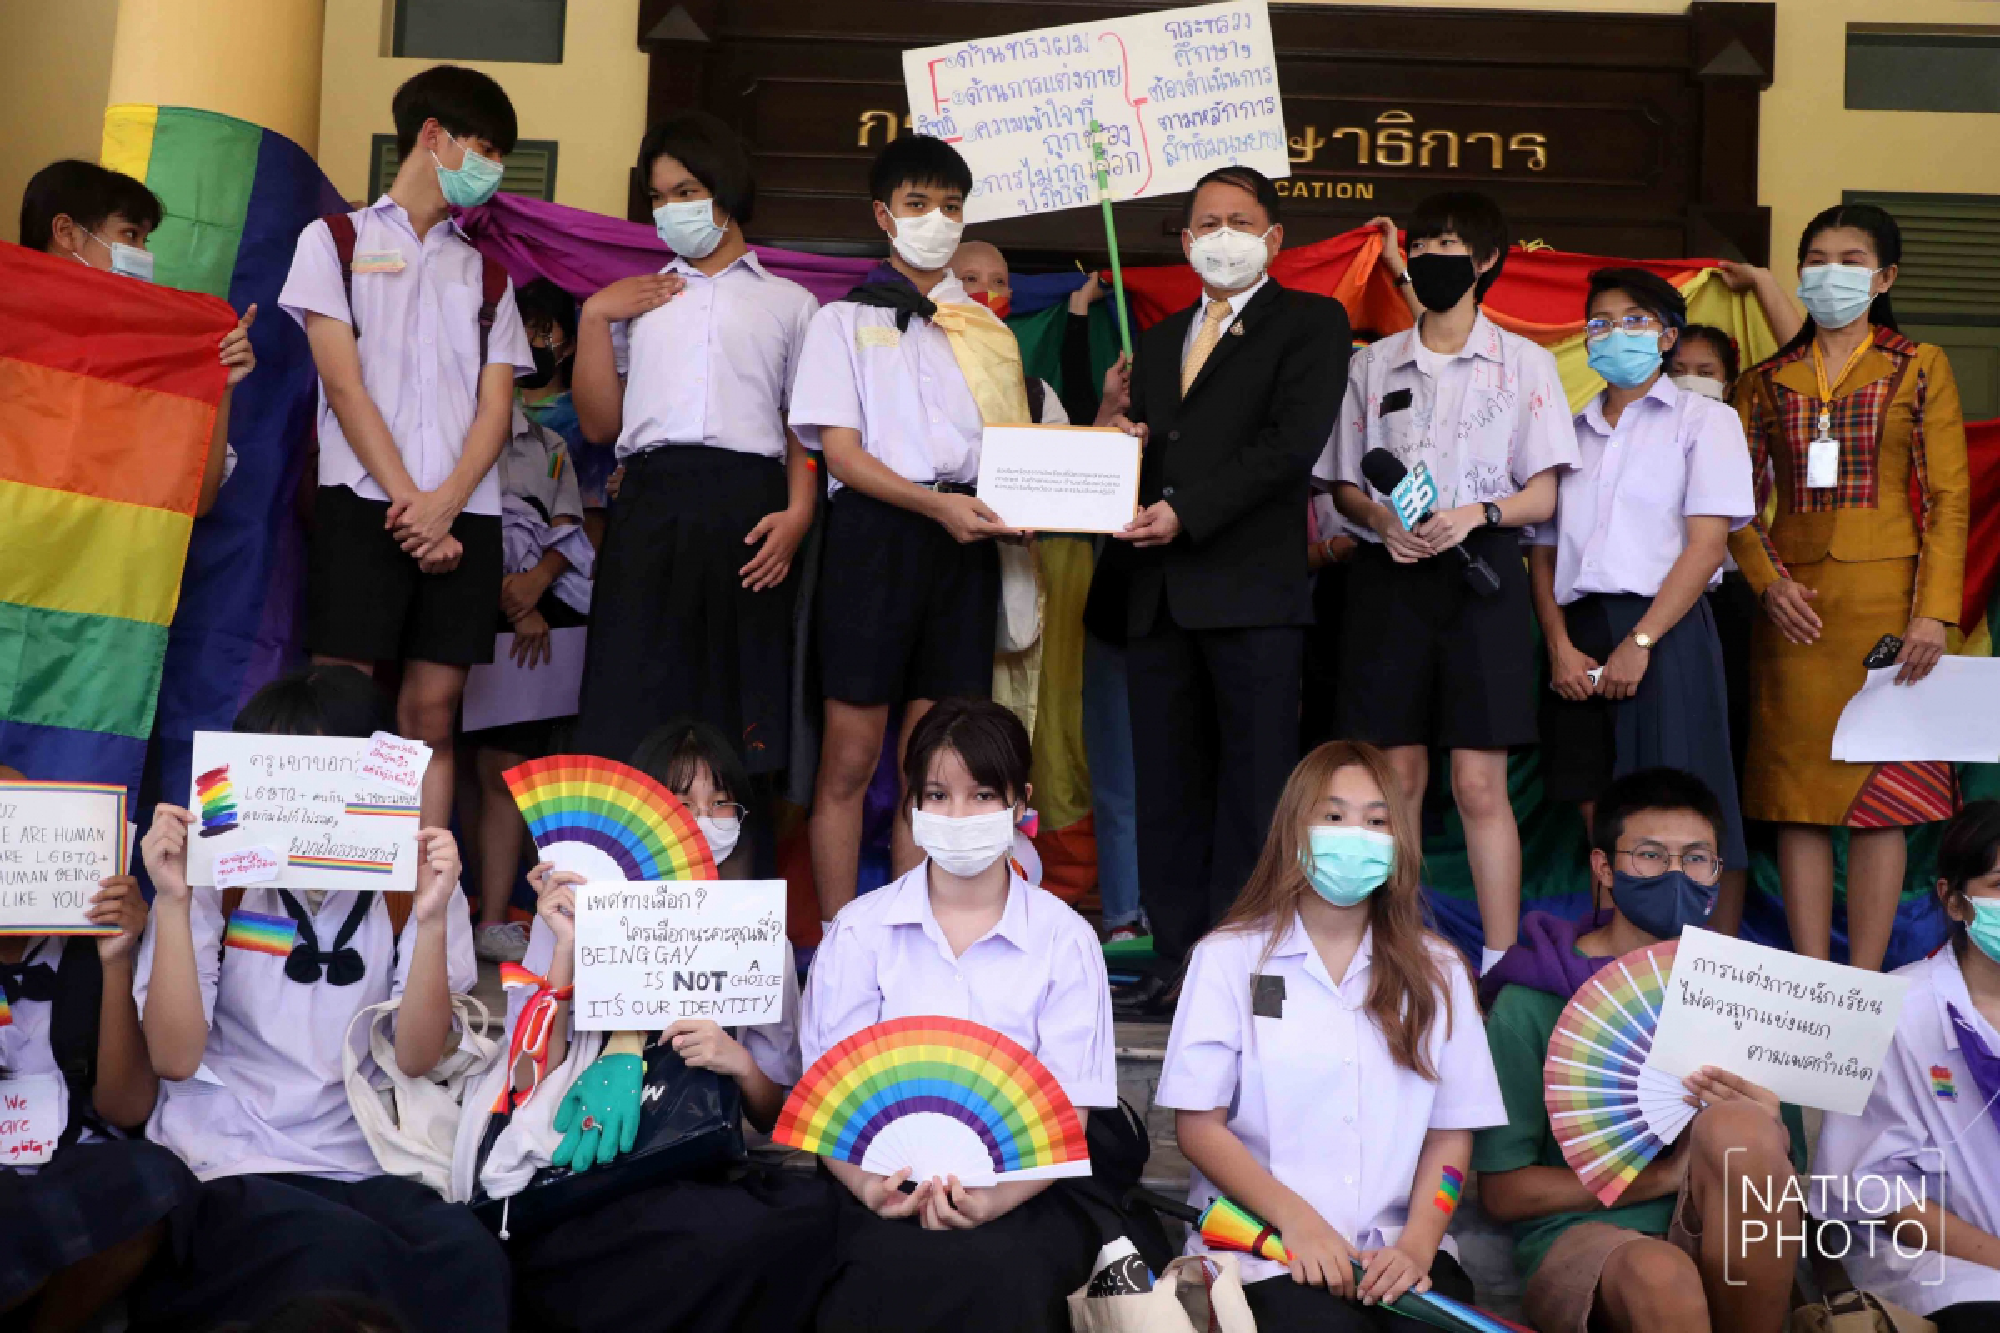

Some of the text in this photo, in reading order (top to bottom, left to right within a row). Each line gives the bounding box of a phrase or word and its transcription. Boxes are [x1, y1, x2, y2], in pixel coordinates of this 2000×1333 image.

[1157, 97, 1275, 132] ตามหลักการ
[1274, 180, 1374, 199] CATION
[2, 826, 106, 843] E ARE HUMAN
[36, 850, 108, 866] LGBTQ+
[55, 868, 101, 882] BEING
[2, 890, 85, 909] LIKE YOU
[581, 944, 698, 966] BEING GAY
[748, 960, 760, 972] A
[643, 970, 783, 993] IS NOT CHOICE
[1693, 957, 1883, 1015] การแต่งกายนักเรียน
[632, 1000, 670, 1016] OUR
[678, 994, 777, 1017] IDENTITY
[1747, 1044, 1873, 1081] ตามเพศกำเนิด
[5, 1093, 28, 1110] We
